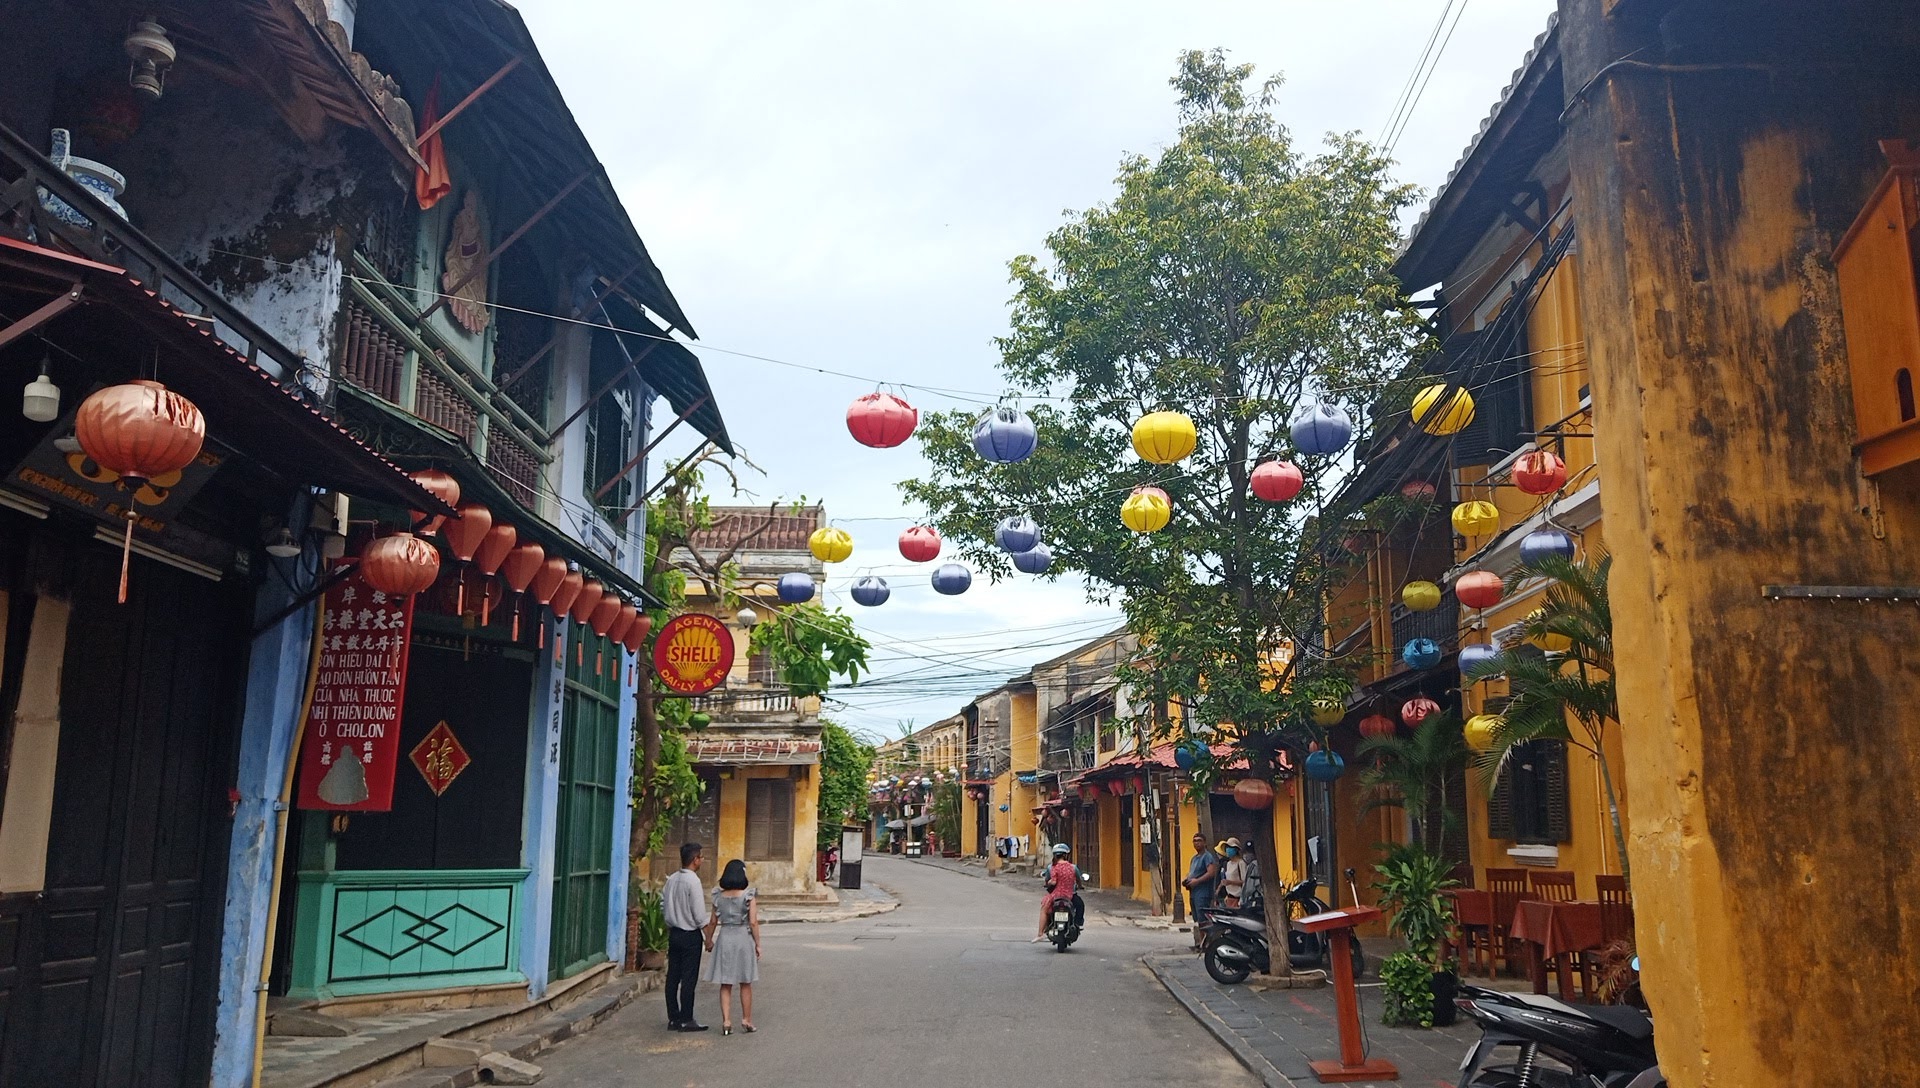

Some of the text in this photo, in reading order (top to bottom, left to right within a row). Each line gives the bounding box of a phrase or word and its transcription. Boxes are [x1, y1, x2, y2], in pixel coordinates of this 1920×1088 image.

[675, 617, 721, 632] AGENT
[671, 646, 717, 662] SHELL
[336, 723, 385, 738] CHOLON
[426, 737, 455, 780] 福
